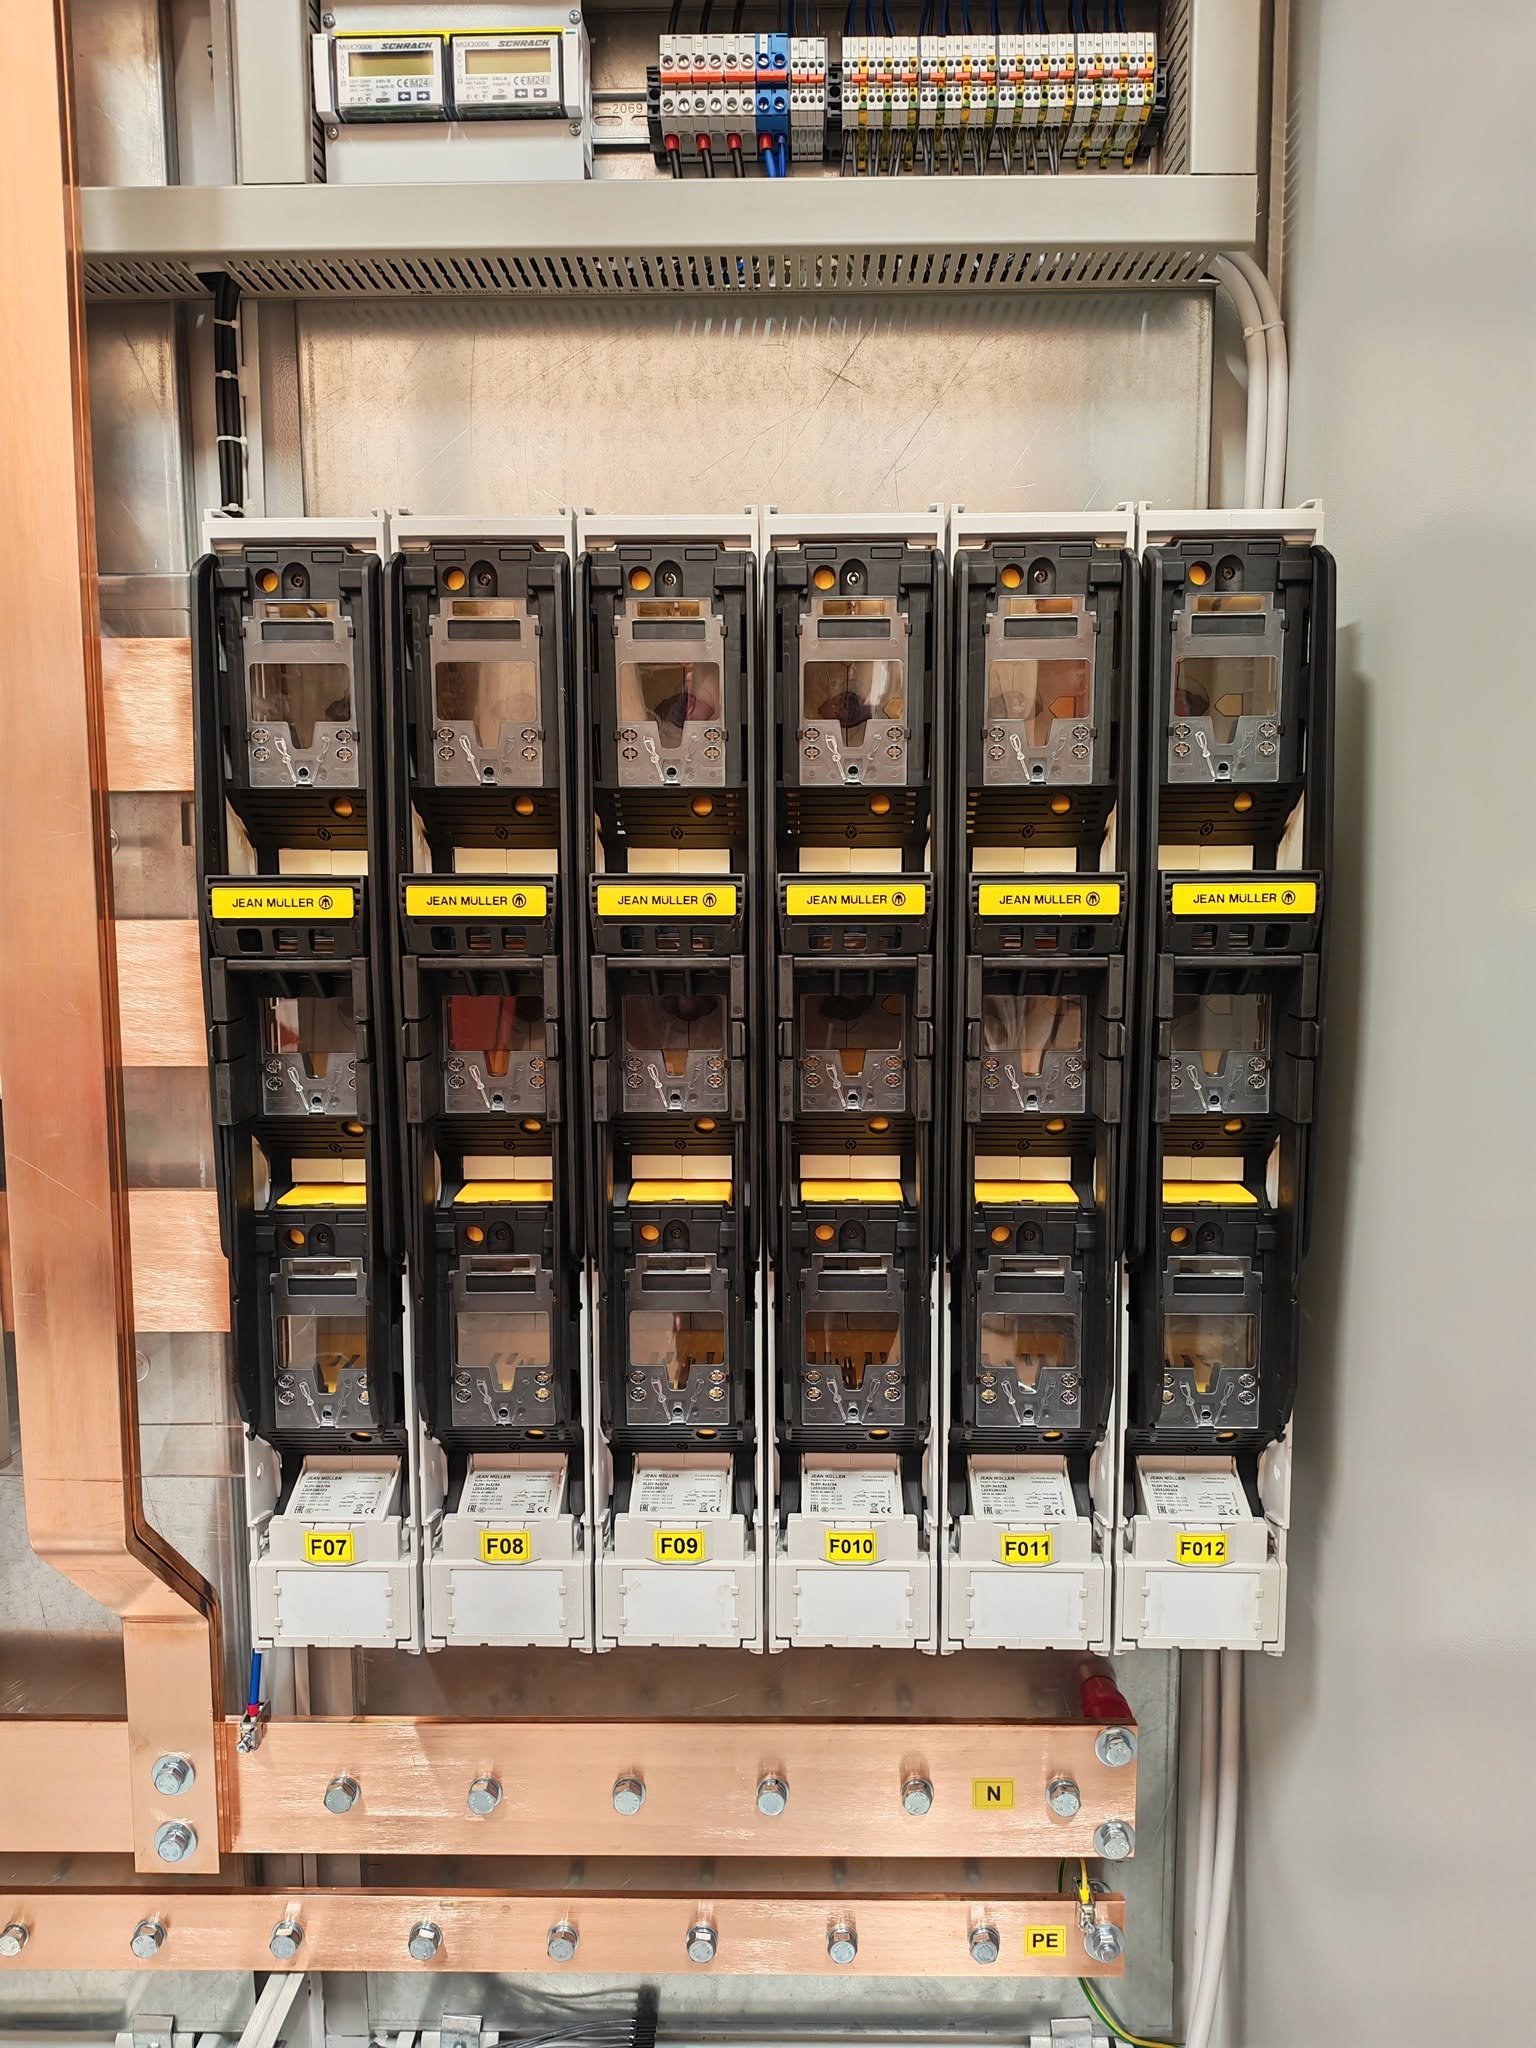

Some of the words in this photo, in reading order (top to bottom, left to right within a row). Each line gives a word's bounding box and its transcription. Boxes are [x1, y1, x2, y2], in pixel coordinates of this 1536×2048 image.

[381, 42, 432, 50] SCHRACK
[498, 39, 549, 47] SCHRACK
[232, 898, 263, 908] JEAN
[426, 896, 457, 906] JEAN
[618, 895, 648, 905] JEAN
[807, 895, 837, 905] JEAN
[1000, 895, 1031, 905] JEAN
[1193, 894, 1225, 904] JEAN
[311, 1539, 347, 1556] F07
[487, 1538, 524, 1555] F08
[661, 1537, 698, 1554] F09
[829, 1539, 873, 1554] F010
[1005, 1540, 1049, 1557] F011
[1181, 1541, 1225, 1556] F012
[986, 1785, 1001, 1801] N
[1032, 1933, 1059, 1948] PE
